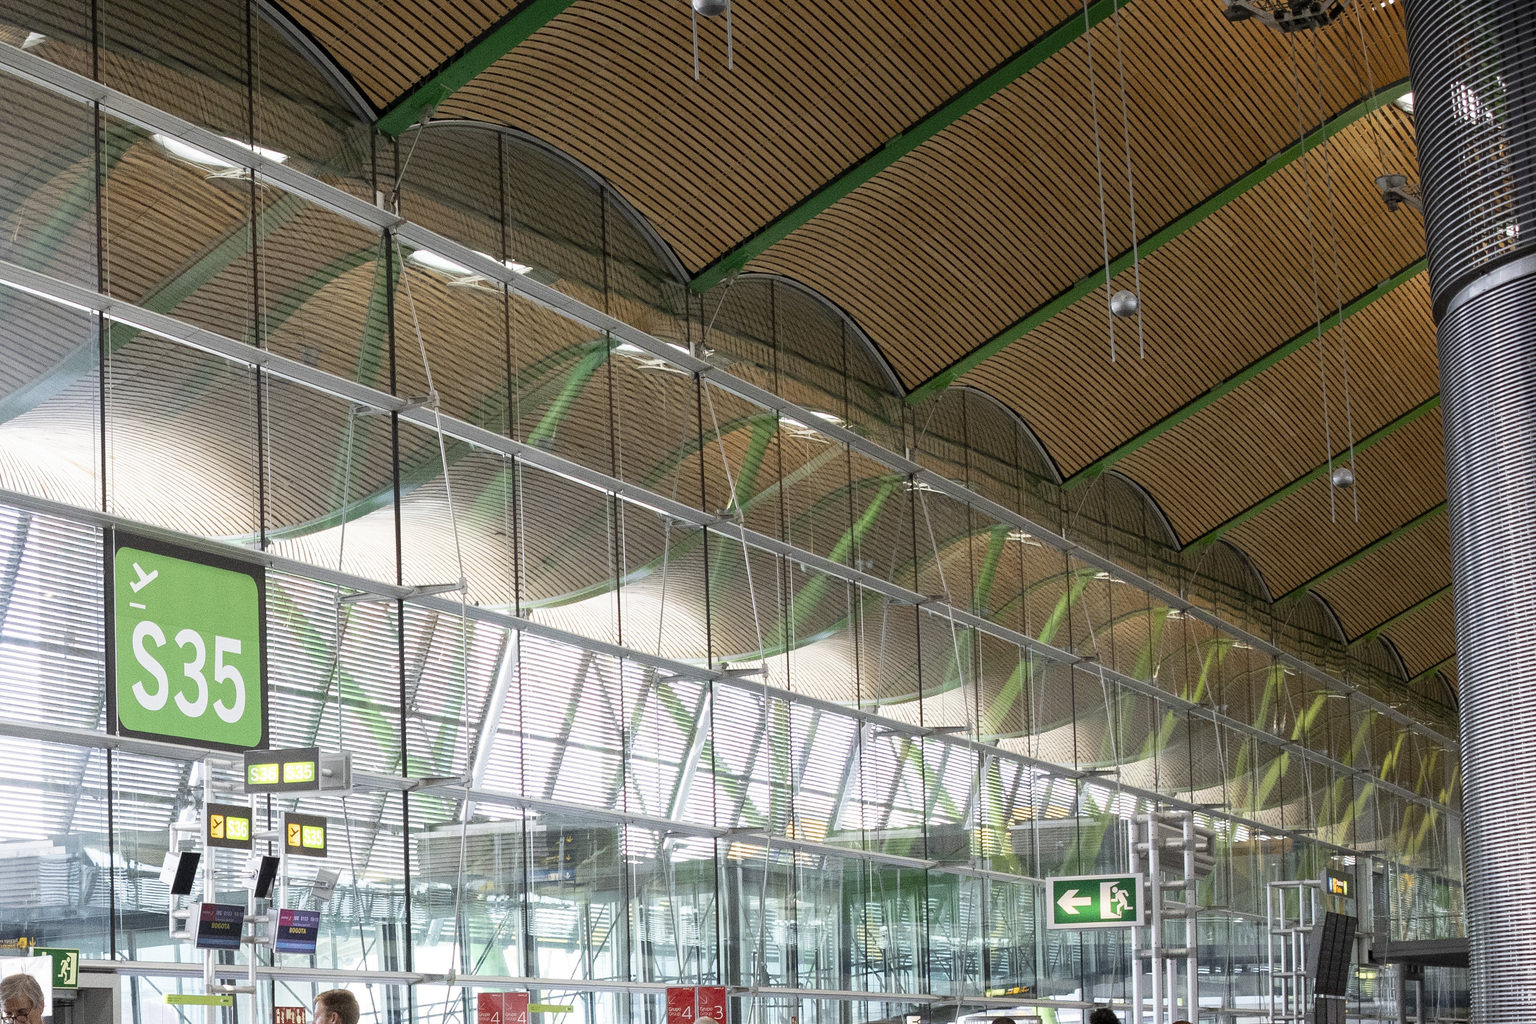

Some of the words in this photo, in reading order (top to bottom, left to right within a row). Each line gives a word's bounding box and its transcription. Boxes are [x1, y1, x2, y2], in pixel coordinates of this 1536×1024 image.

[131, 620, 246, 724] S35
[250, 766, 277, 782] S36
[285, 764, 313, 780] S35
[228, 820, 247, 837] S36
[303, 828, 322, 845] S35
[491, 1012, 500, 1024] 4
[517, 1012, 526, 1024] 4
[682, 1006, 692, 1020] 4
[714, 1006, 724, 1020] 3
